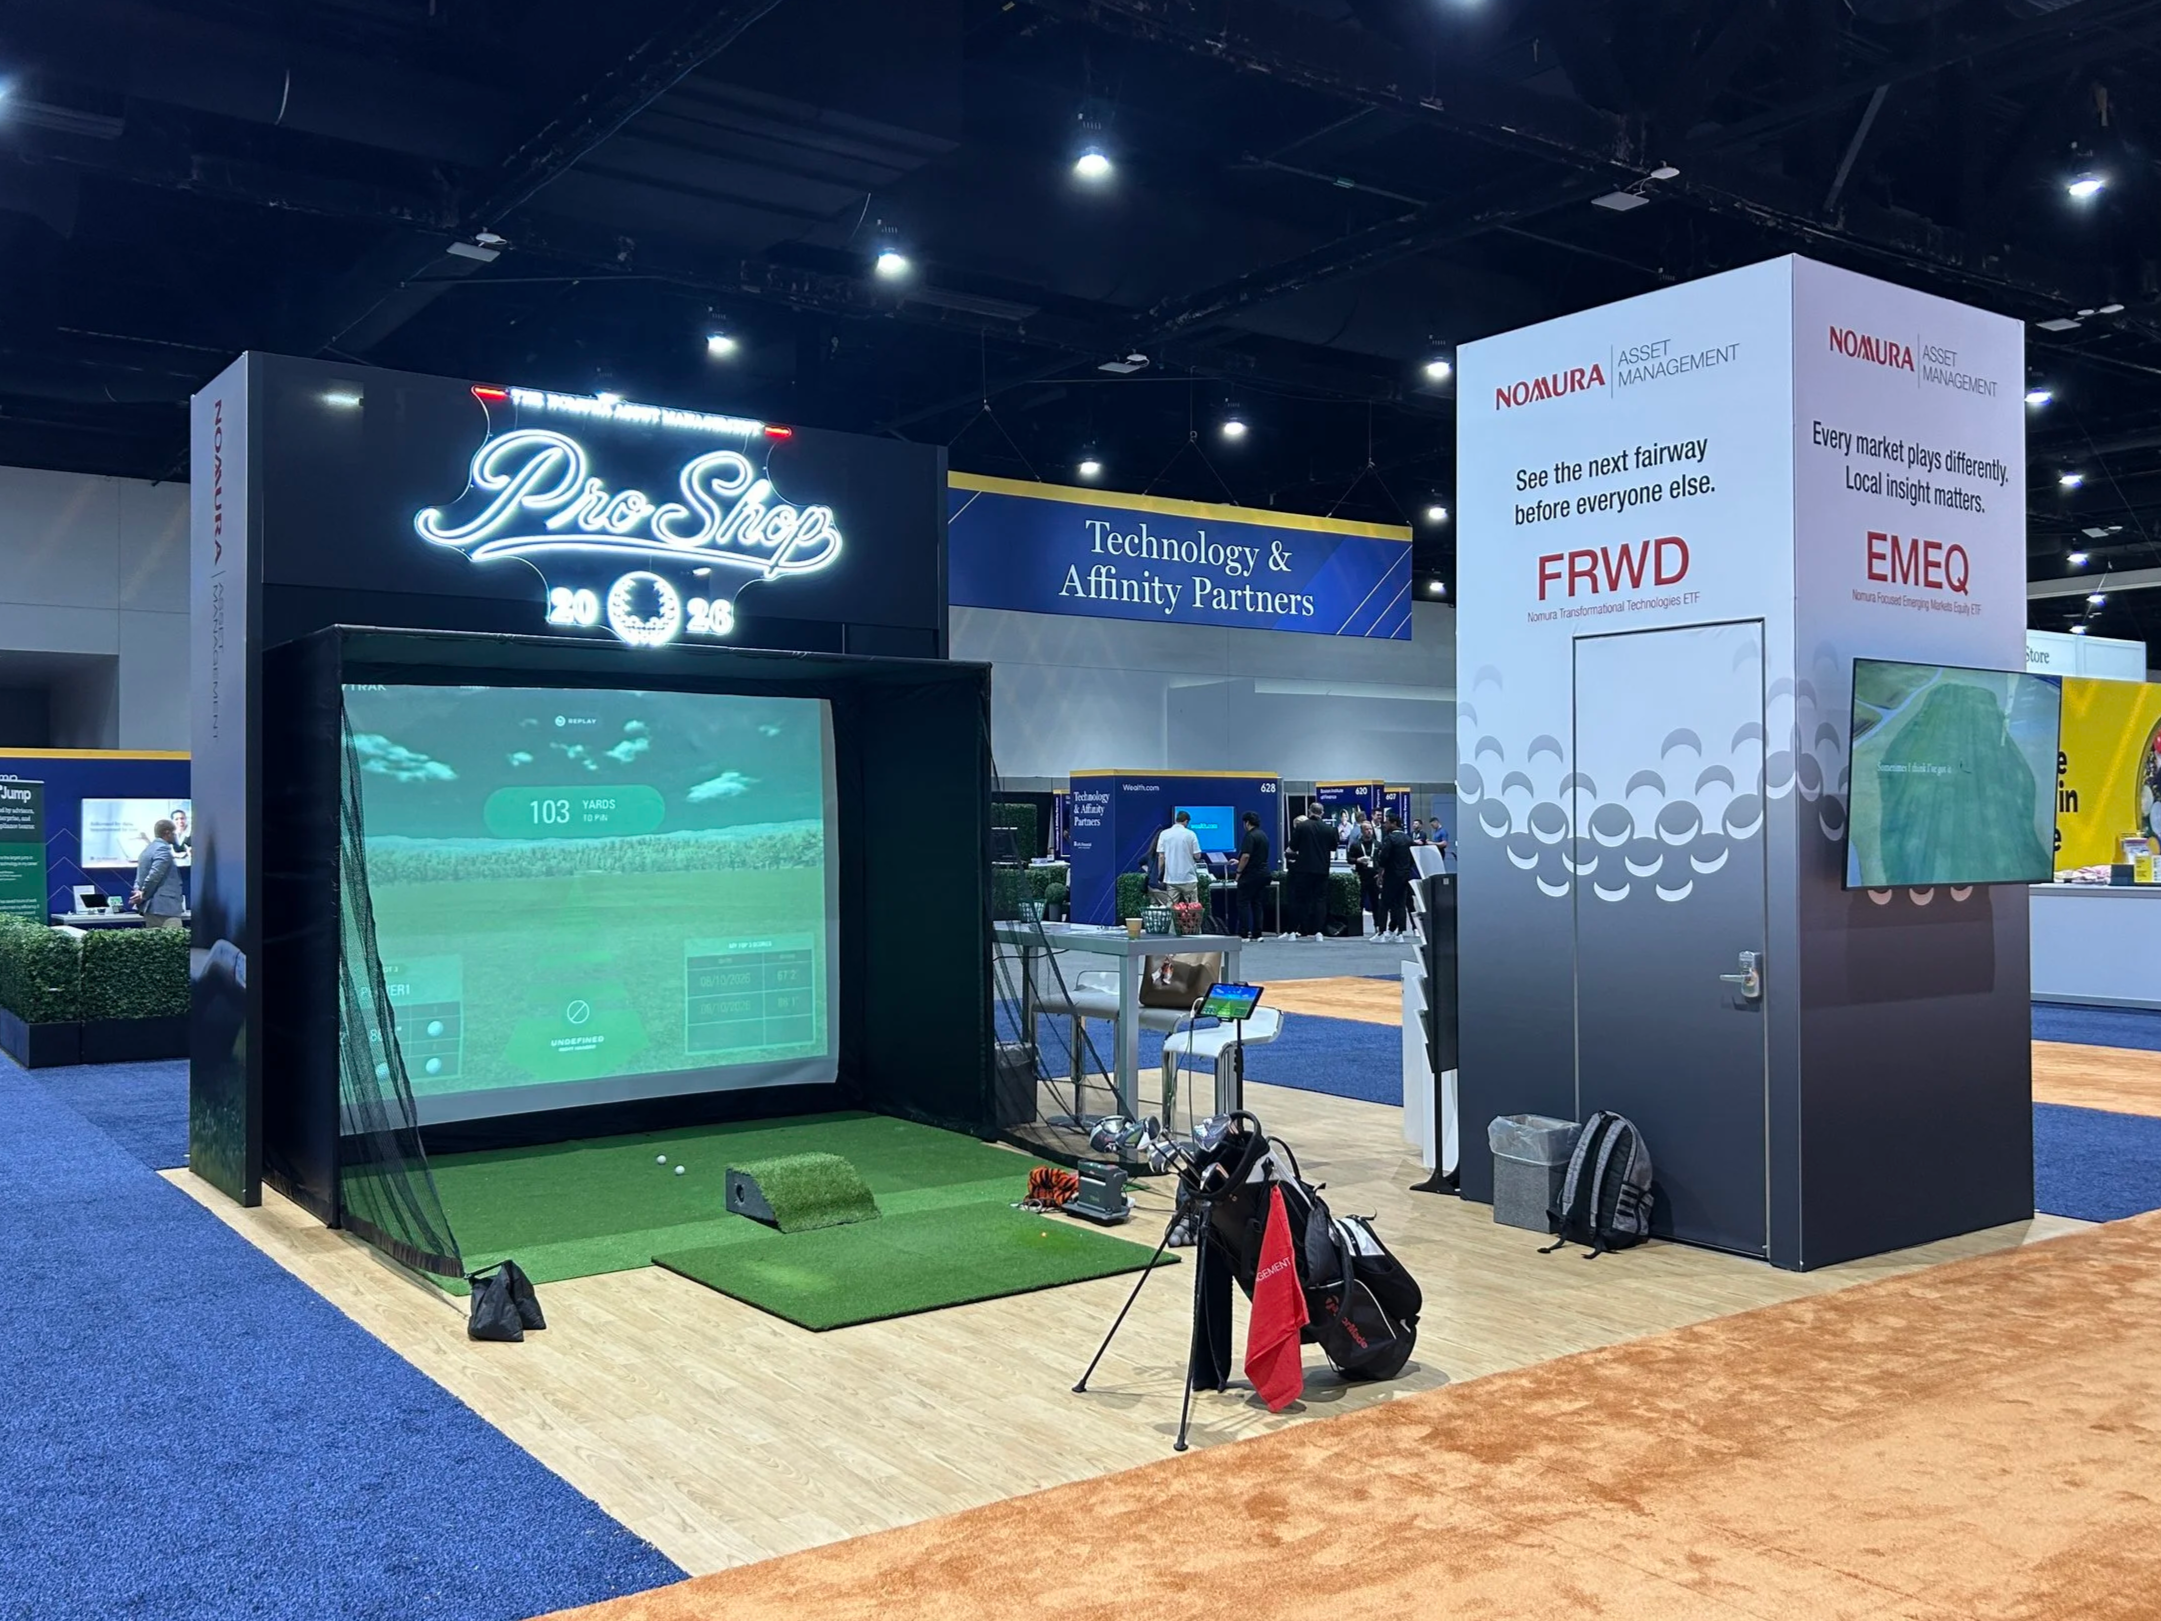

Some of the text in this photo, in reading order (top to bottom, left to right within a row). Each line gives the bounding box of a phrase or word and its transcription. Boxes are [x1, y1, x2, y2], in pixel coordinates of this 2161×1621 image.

[1496, 339, 1740, 411] NOMURA ASSET MANAGEMENT
[1829, 326, 1998, 398] NOMURA ASSET MANAGEMENT
[1516, 438, 1708, 491] See the next fairway
[1812, 420, 2009, 487] Every market plays differently.
[214, 400, 223, 567] NOMURA
[1515, 473, 1716, 526] before everyone else.
[1846, 466, 1985, 514] Local insight matters.
[415, 429, 843, 579] Pro Shop
[1085, 518, 1293, 577] Technology &
[1867, 530, 1970, 596] EMEQ
[1538, 536, 1690, 600] FRWD
[550, 587, 598, 626] 20
[1058, 563, 1315, 617] Affinity Partners
[1528, 591, 1700, 622] Nomura Transformational Technologies ETF
[1852, 589, 1982, 616] Nomura Focused Emerging Markets Equity ETF
[212, 584, 220, 741] MANAGEMENT
[2026, 648, 2050, 664] Store
[1, 786, 31, 804] Jump
[582, 799, 616, 810] YARDS
[1074, 790, 1110, 804] Technology
[1122, 784, 1160, 792] Wealth.com
[1260, 783, 1276, 793] 628
[1355, 787, 1368, 795] 620
[530, 800, 570, 824] 103
[1074, 803, 1105, 816] & Affinity
[1074, 816, 1100, 826] Partners
[360, 984, 410, 997] PER1
[550, 1036, 604, 1046] UNDEFINED
